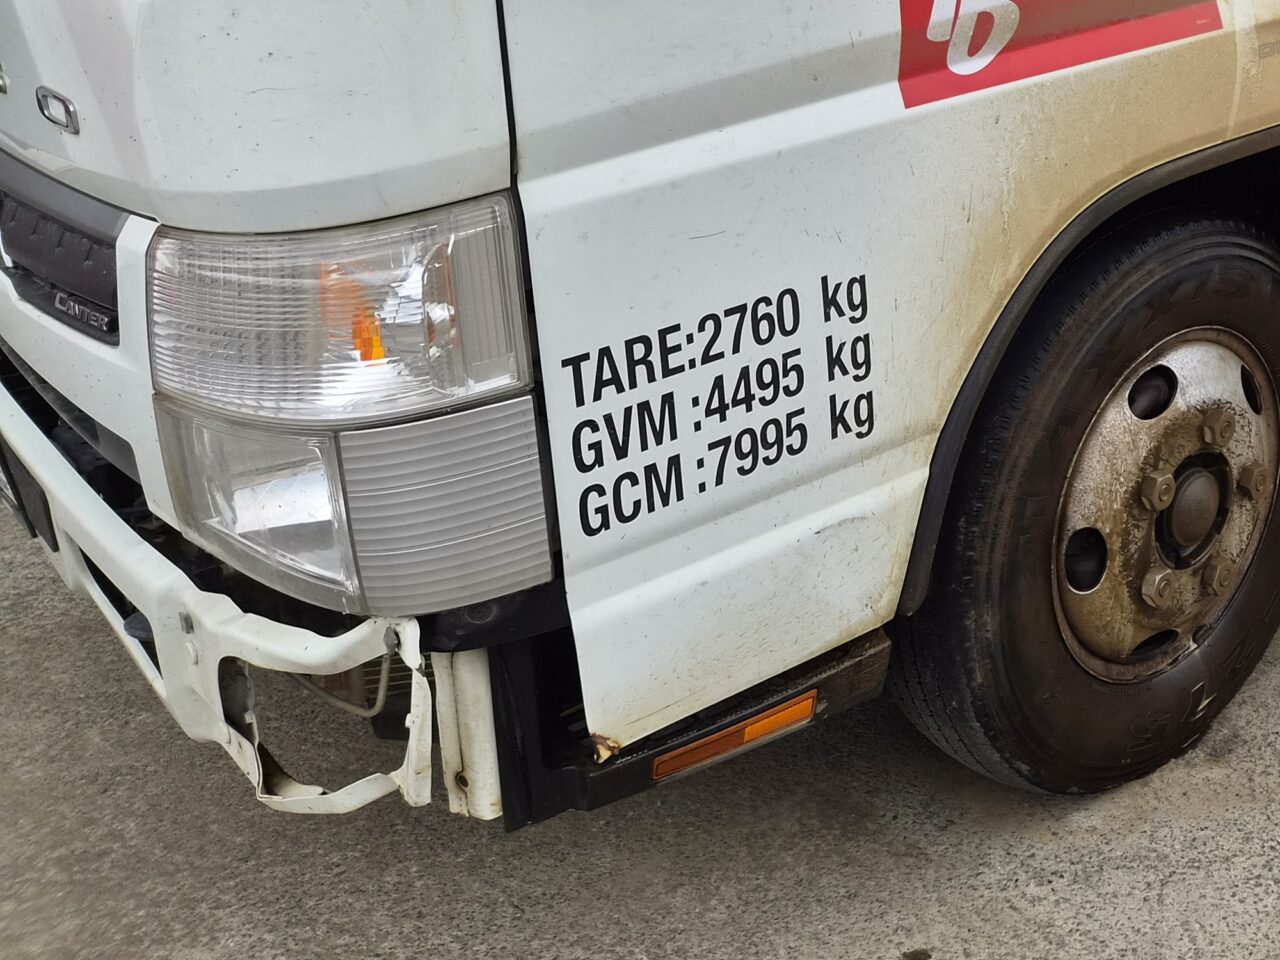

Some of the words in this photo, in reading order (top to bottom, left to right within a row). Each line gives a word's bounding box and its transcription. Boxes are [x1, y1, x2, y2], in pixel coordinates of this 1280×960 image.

[53, 291, 110, 332] CANTER
[820, 273, 868, 324] kg
[571, 391, 679, 474] GVM
[825, 333, 872, 383] kg
[578, 453, 685, 537] GCM
[828, 390, 875, 440] kg
